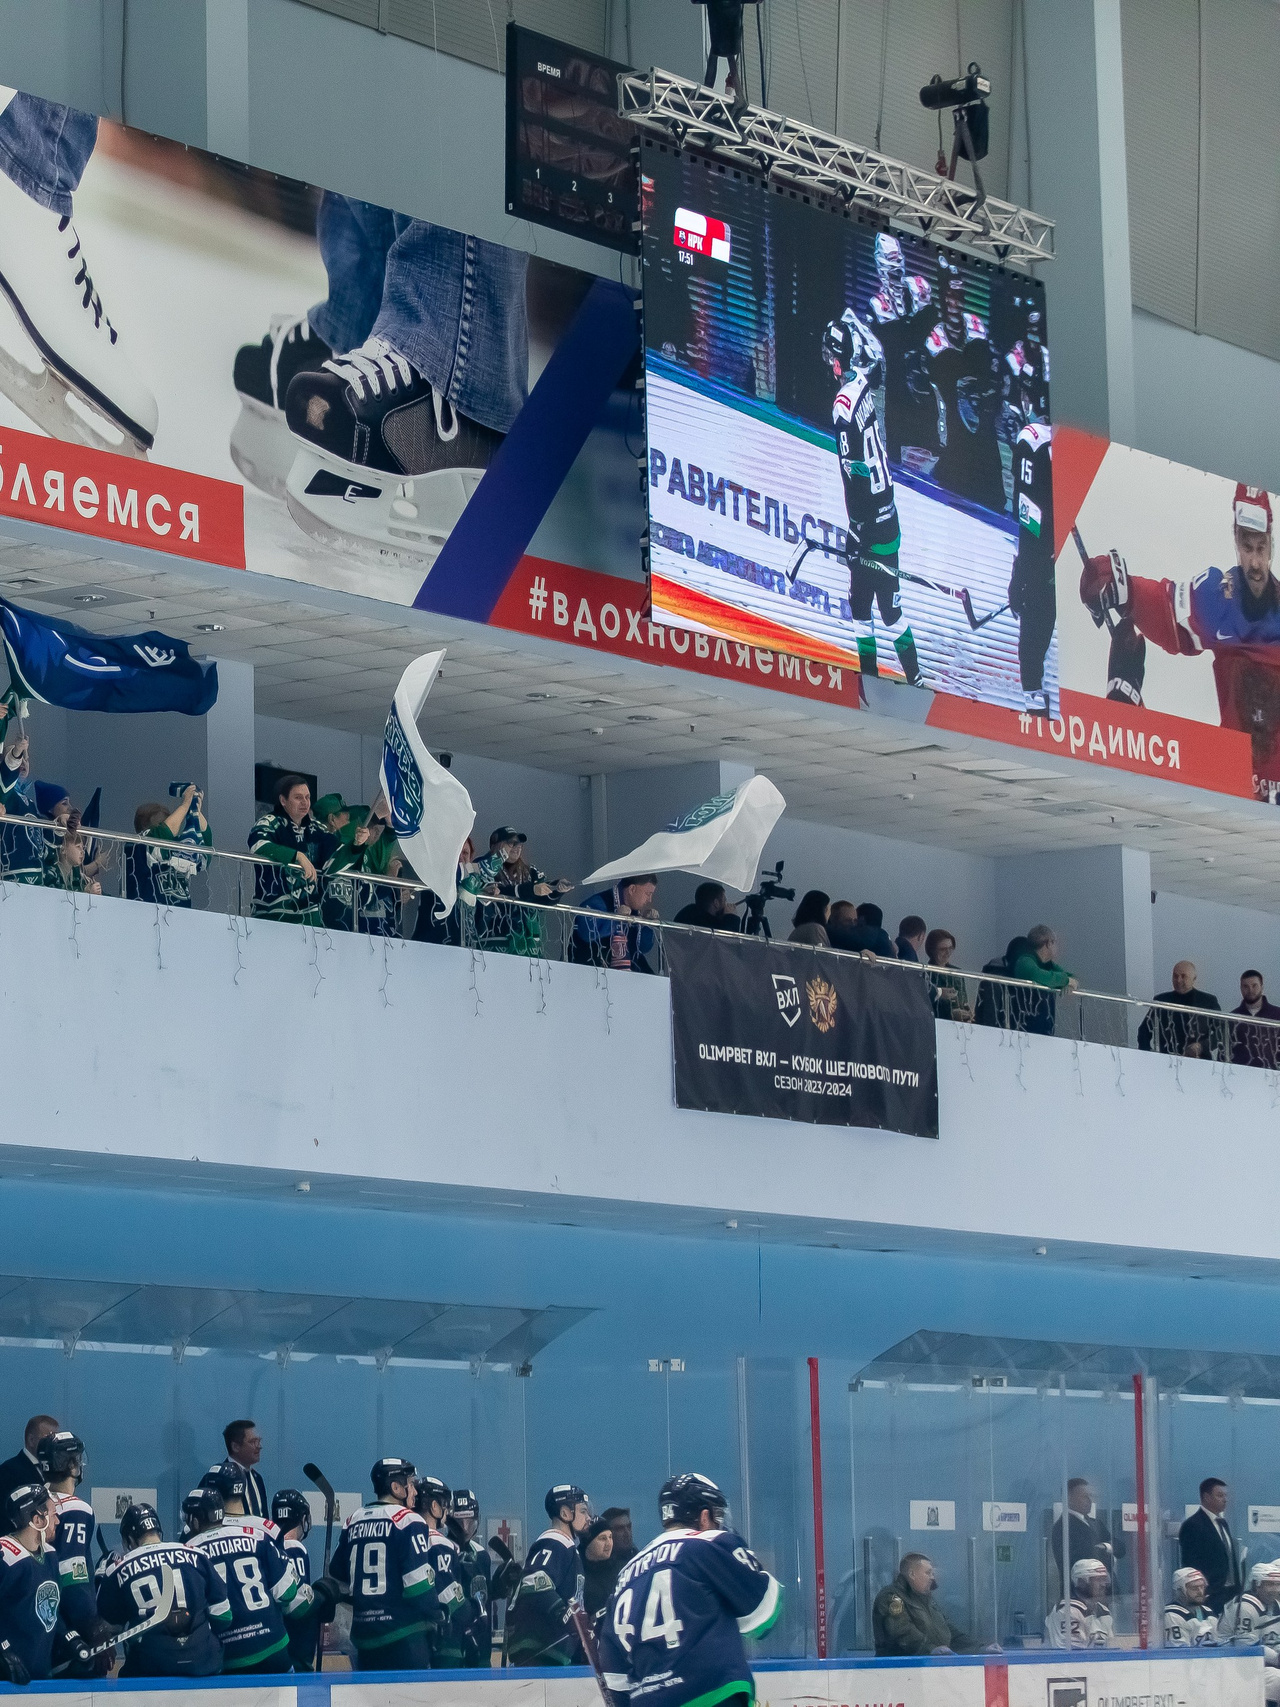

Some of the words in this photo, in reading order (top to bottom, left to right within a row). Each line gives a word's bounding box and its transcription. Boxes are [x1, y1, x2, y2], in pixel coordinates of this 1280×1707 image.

[537, 61, 561, 79] ВРЕМЯ
[535, 168, 541, 179] 1
[572, 180, 577, 192] 2
[607, 192, 613, 204] 3
[678, 250, 694, 266] 17:51
[1020, 457, 1033, 485] 15
[776, 986, 800, 1010] ВХЛ
[698, 1043, 753, 1068] OLIMPBET
[755, 1050, 777, 1068] ВХЛ
[791, 1055, 823, 1076] КУБОК
[825, 1060, 890, 1083] ШЕЛКОВОГО
[892, 1069, 919, 1088] ПУТИ
[774, 1075, 803, 1091] СЕЗОН
[804, 1078, 852, 1097] 2023/2024
[233, 1483, 243, 1494] 52
[144, 1517, 156, 1530] 91
[277, 1506, 289, 1519] 90
[64, 1522, 86, 1544] 75
[349, 1521, 393, 1543] HERNIKOV
[200, 1537, 258, 1559] SATDAROV
[411, 1533, 429, 1555] 19
[116, 1550, 198, 1588] ASTASHEVSKY
[349, 1541, 387, 1596] 19
[130, 1568, 188, 1616] 91
